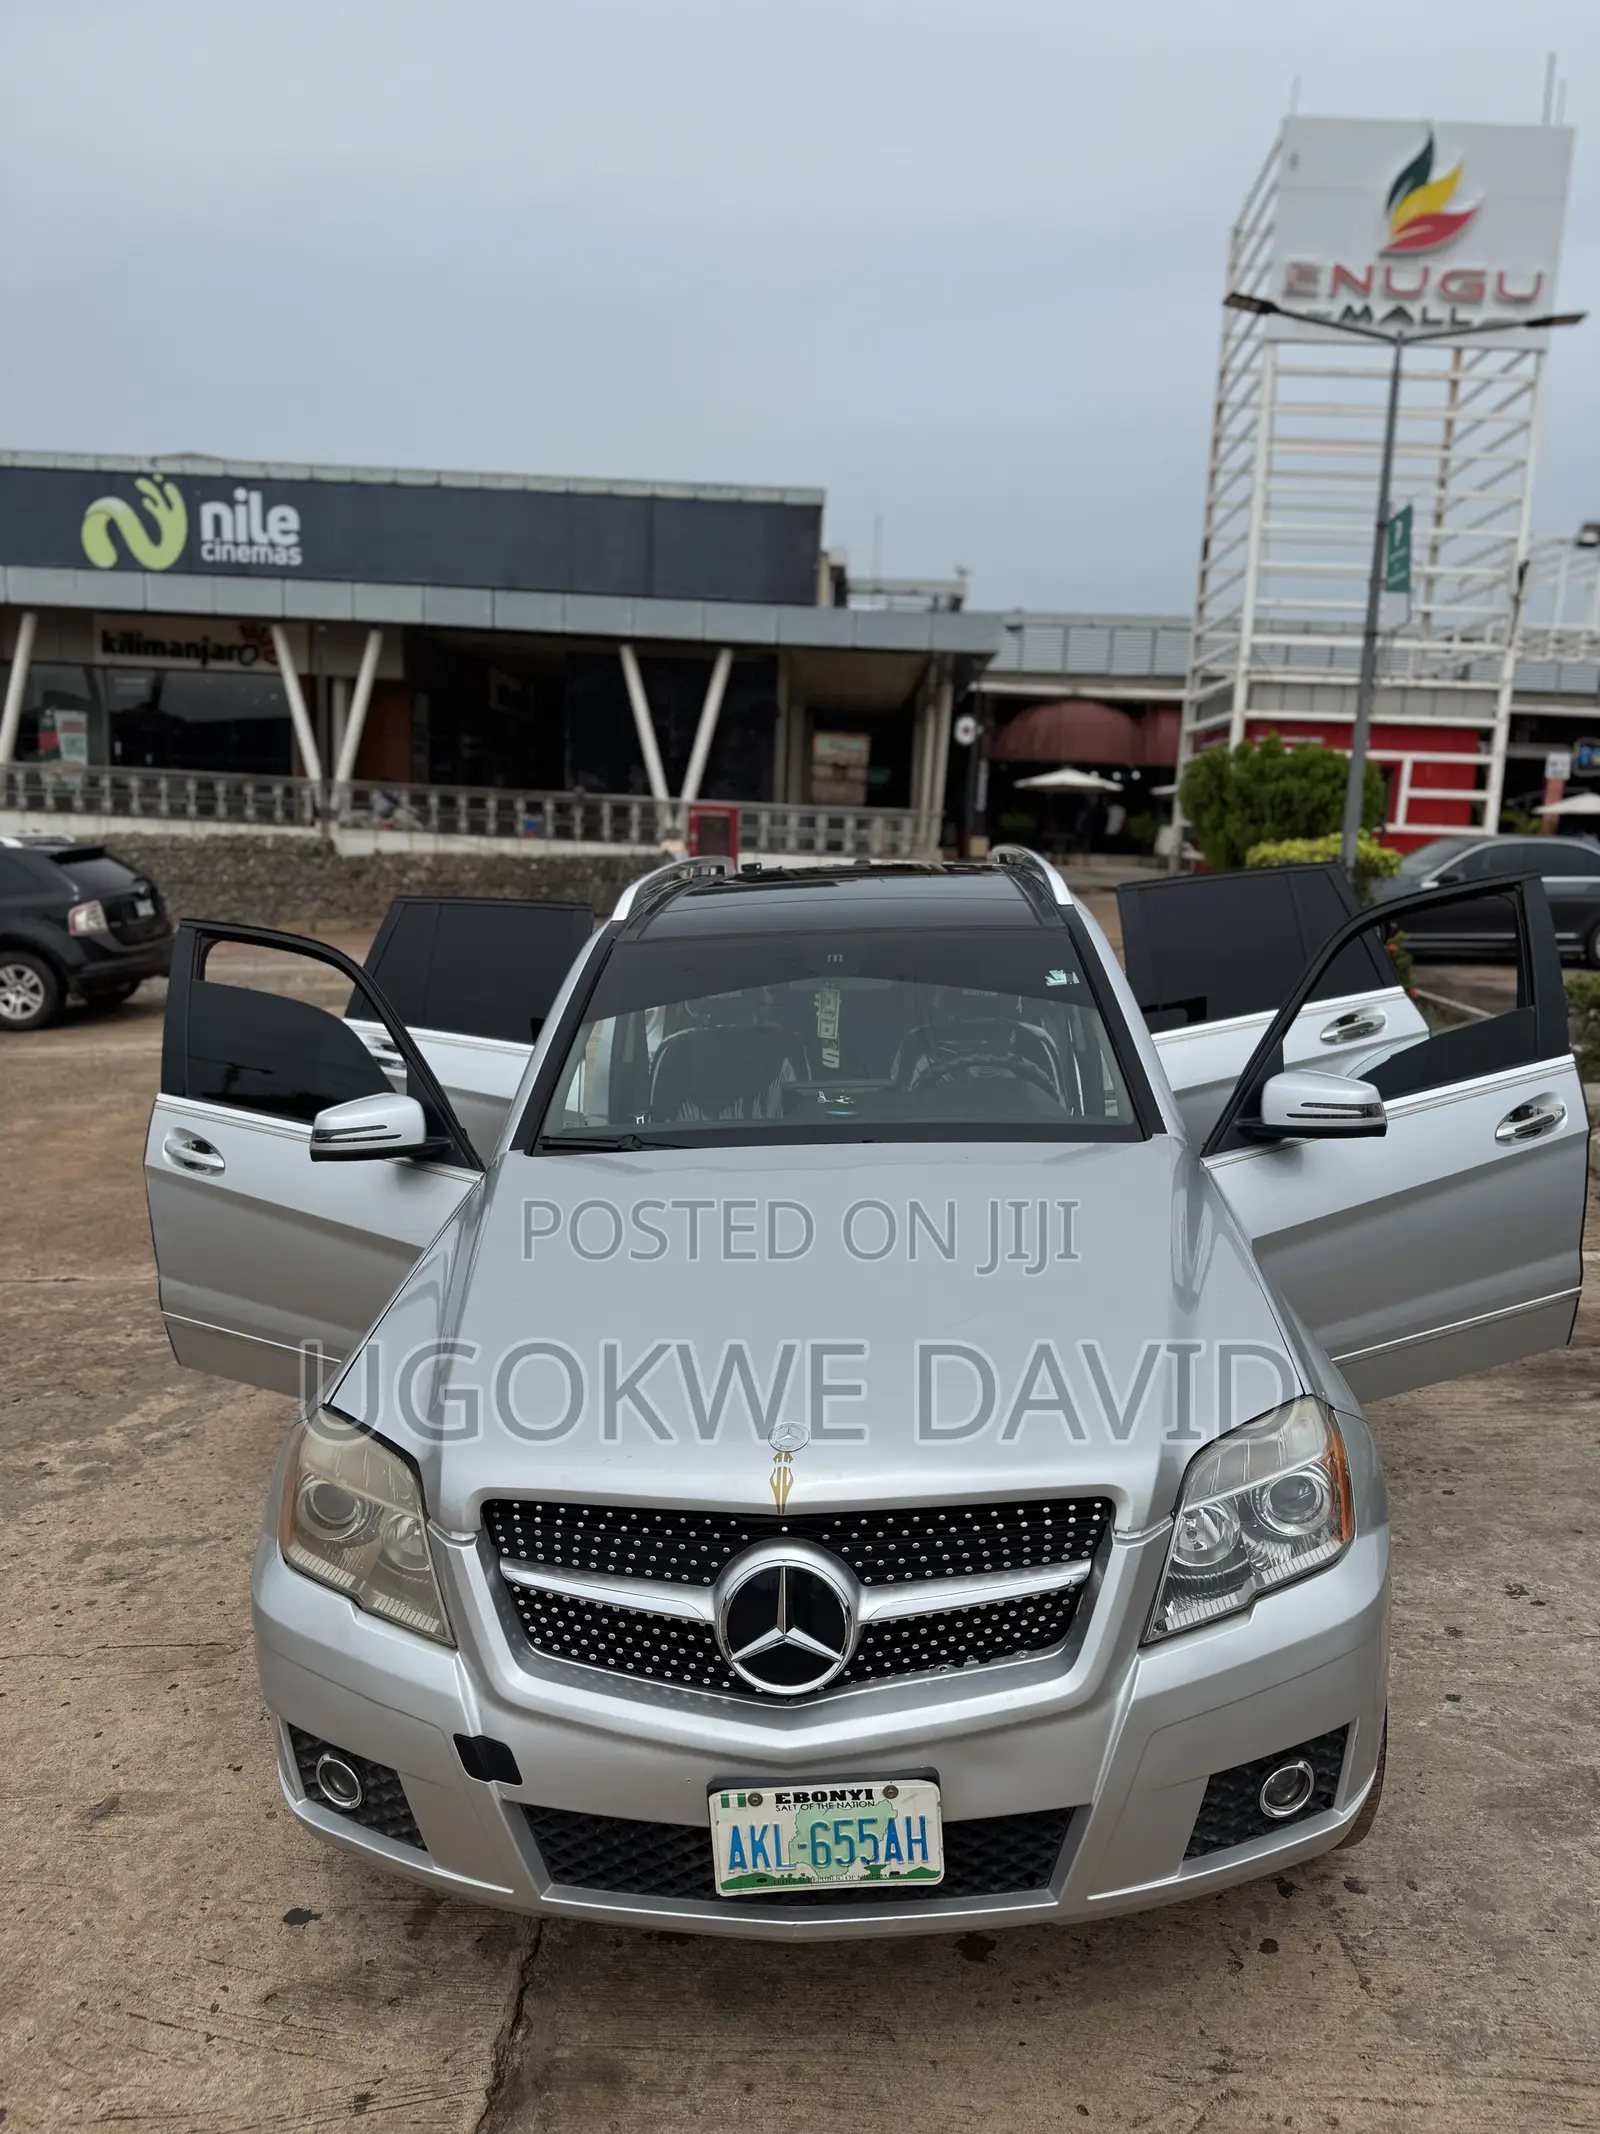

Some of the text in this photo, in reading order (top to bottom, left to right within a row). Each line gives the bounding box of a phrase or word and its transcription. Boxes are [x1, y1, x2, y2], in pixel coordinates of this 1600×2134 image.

[1284, 261, 1545, 302] ENUGU
[1338, 304, 1474, 327] MALL
[200, 486, 301, 547] nile
[200, 539, 303, 567] cinemas
[101, 629, 259, 668] kilimanjaro
[774, 1788, 875, 1804] EBONYI
[775, 1800, 875, 1812] SALT OF THE NATION
